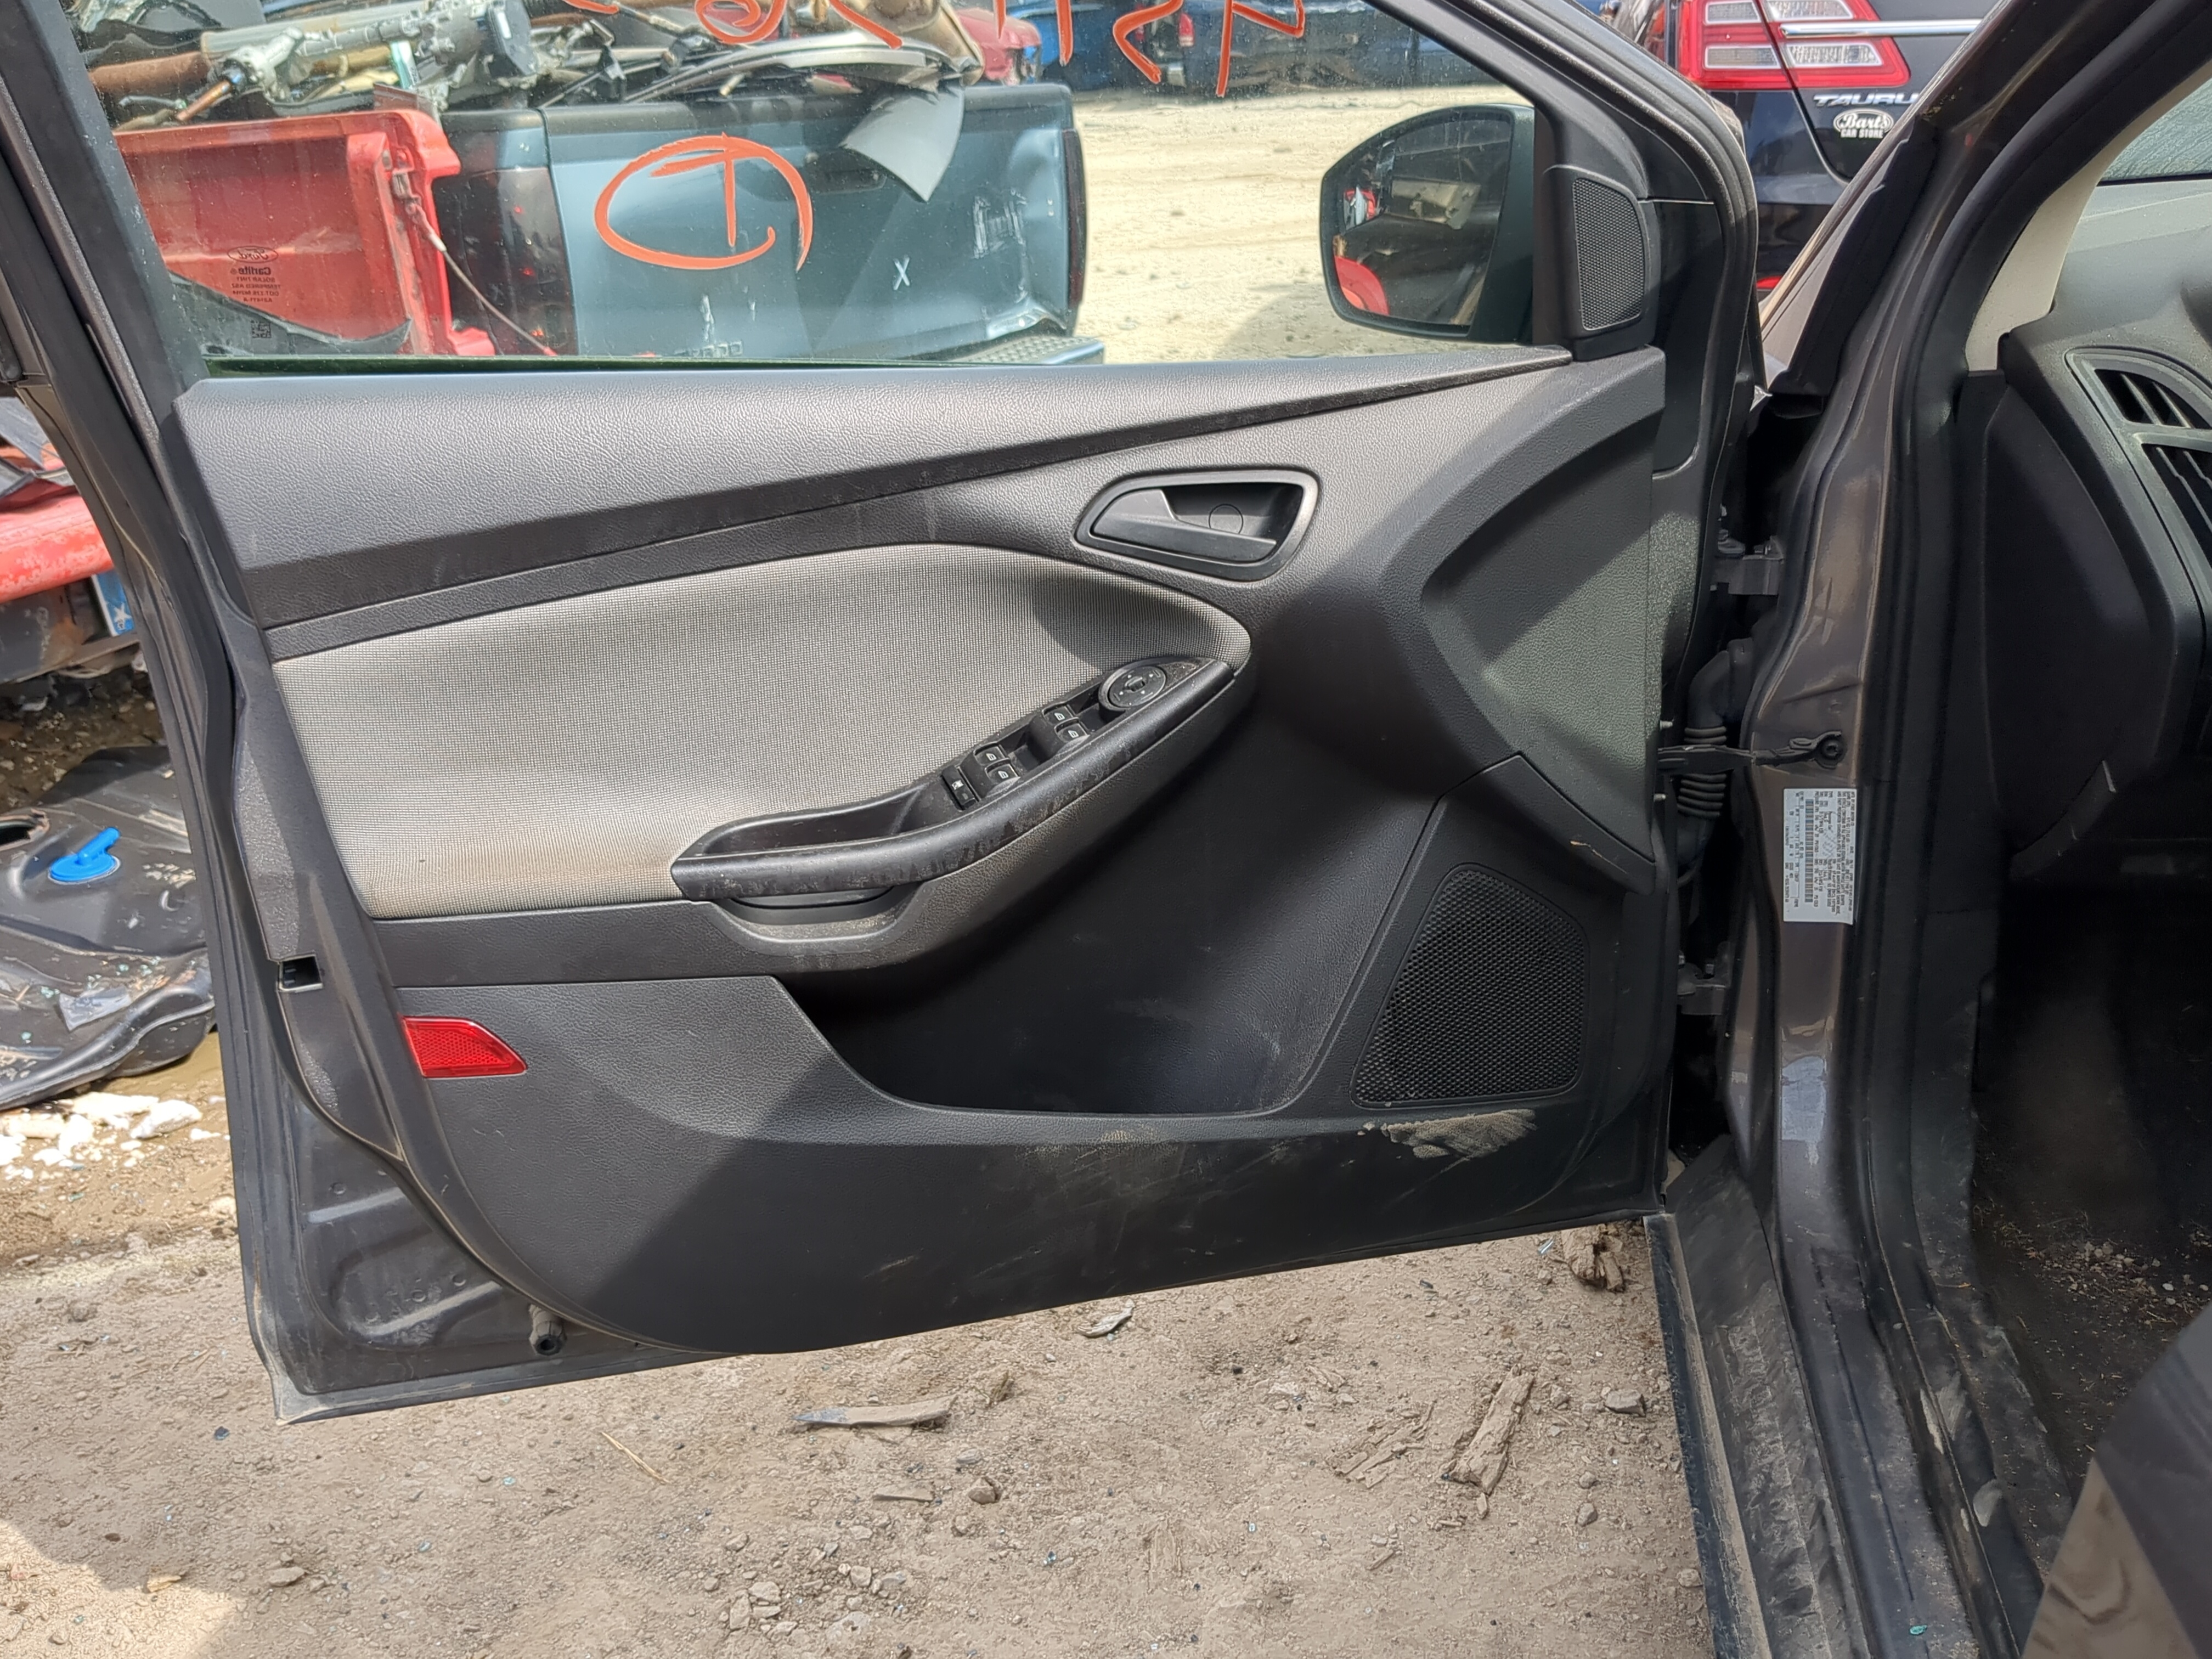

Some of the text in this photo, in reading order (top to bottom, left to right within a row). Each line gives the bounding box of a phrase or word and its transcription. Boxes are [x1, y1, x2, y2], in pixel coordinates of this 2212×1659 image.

[1813, 92, 1920, 106] TAURU
[1840, 128, 1883, 138] CAR STORE
